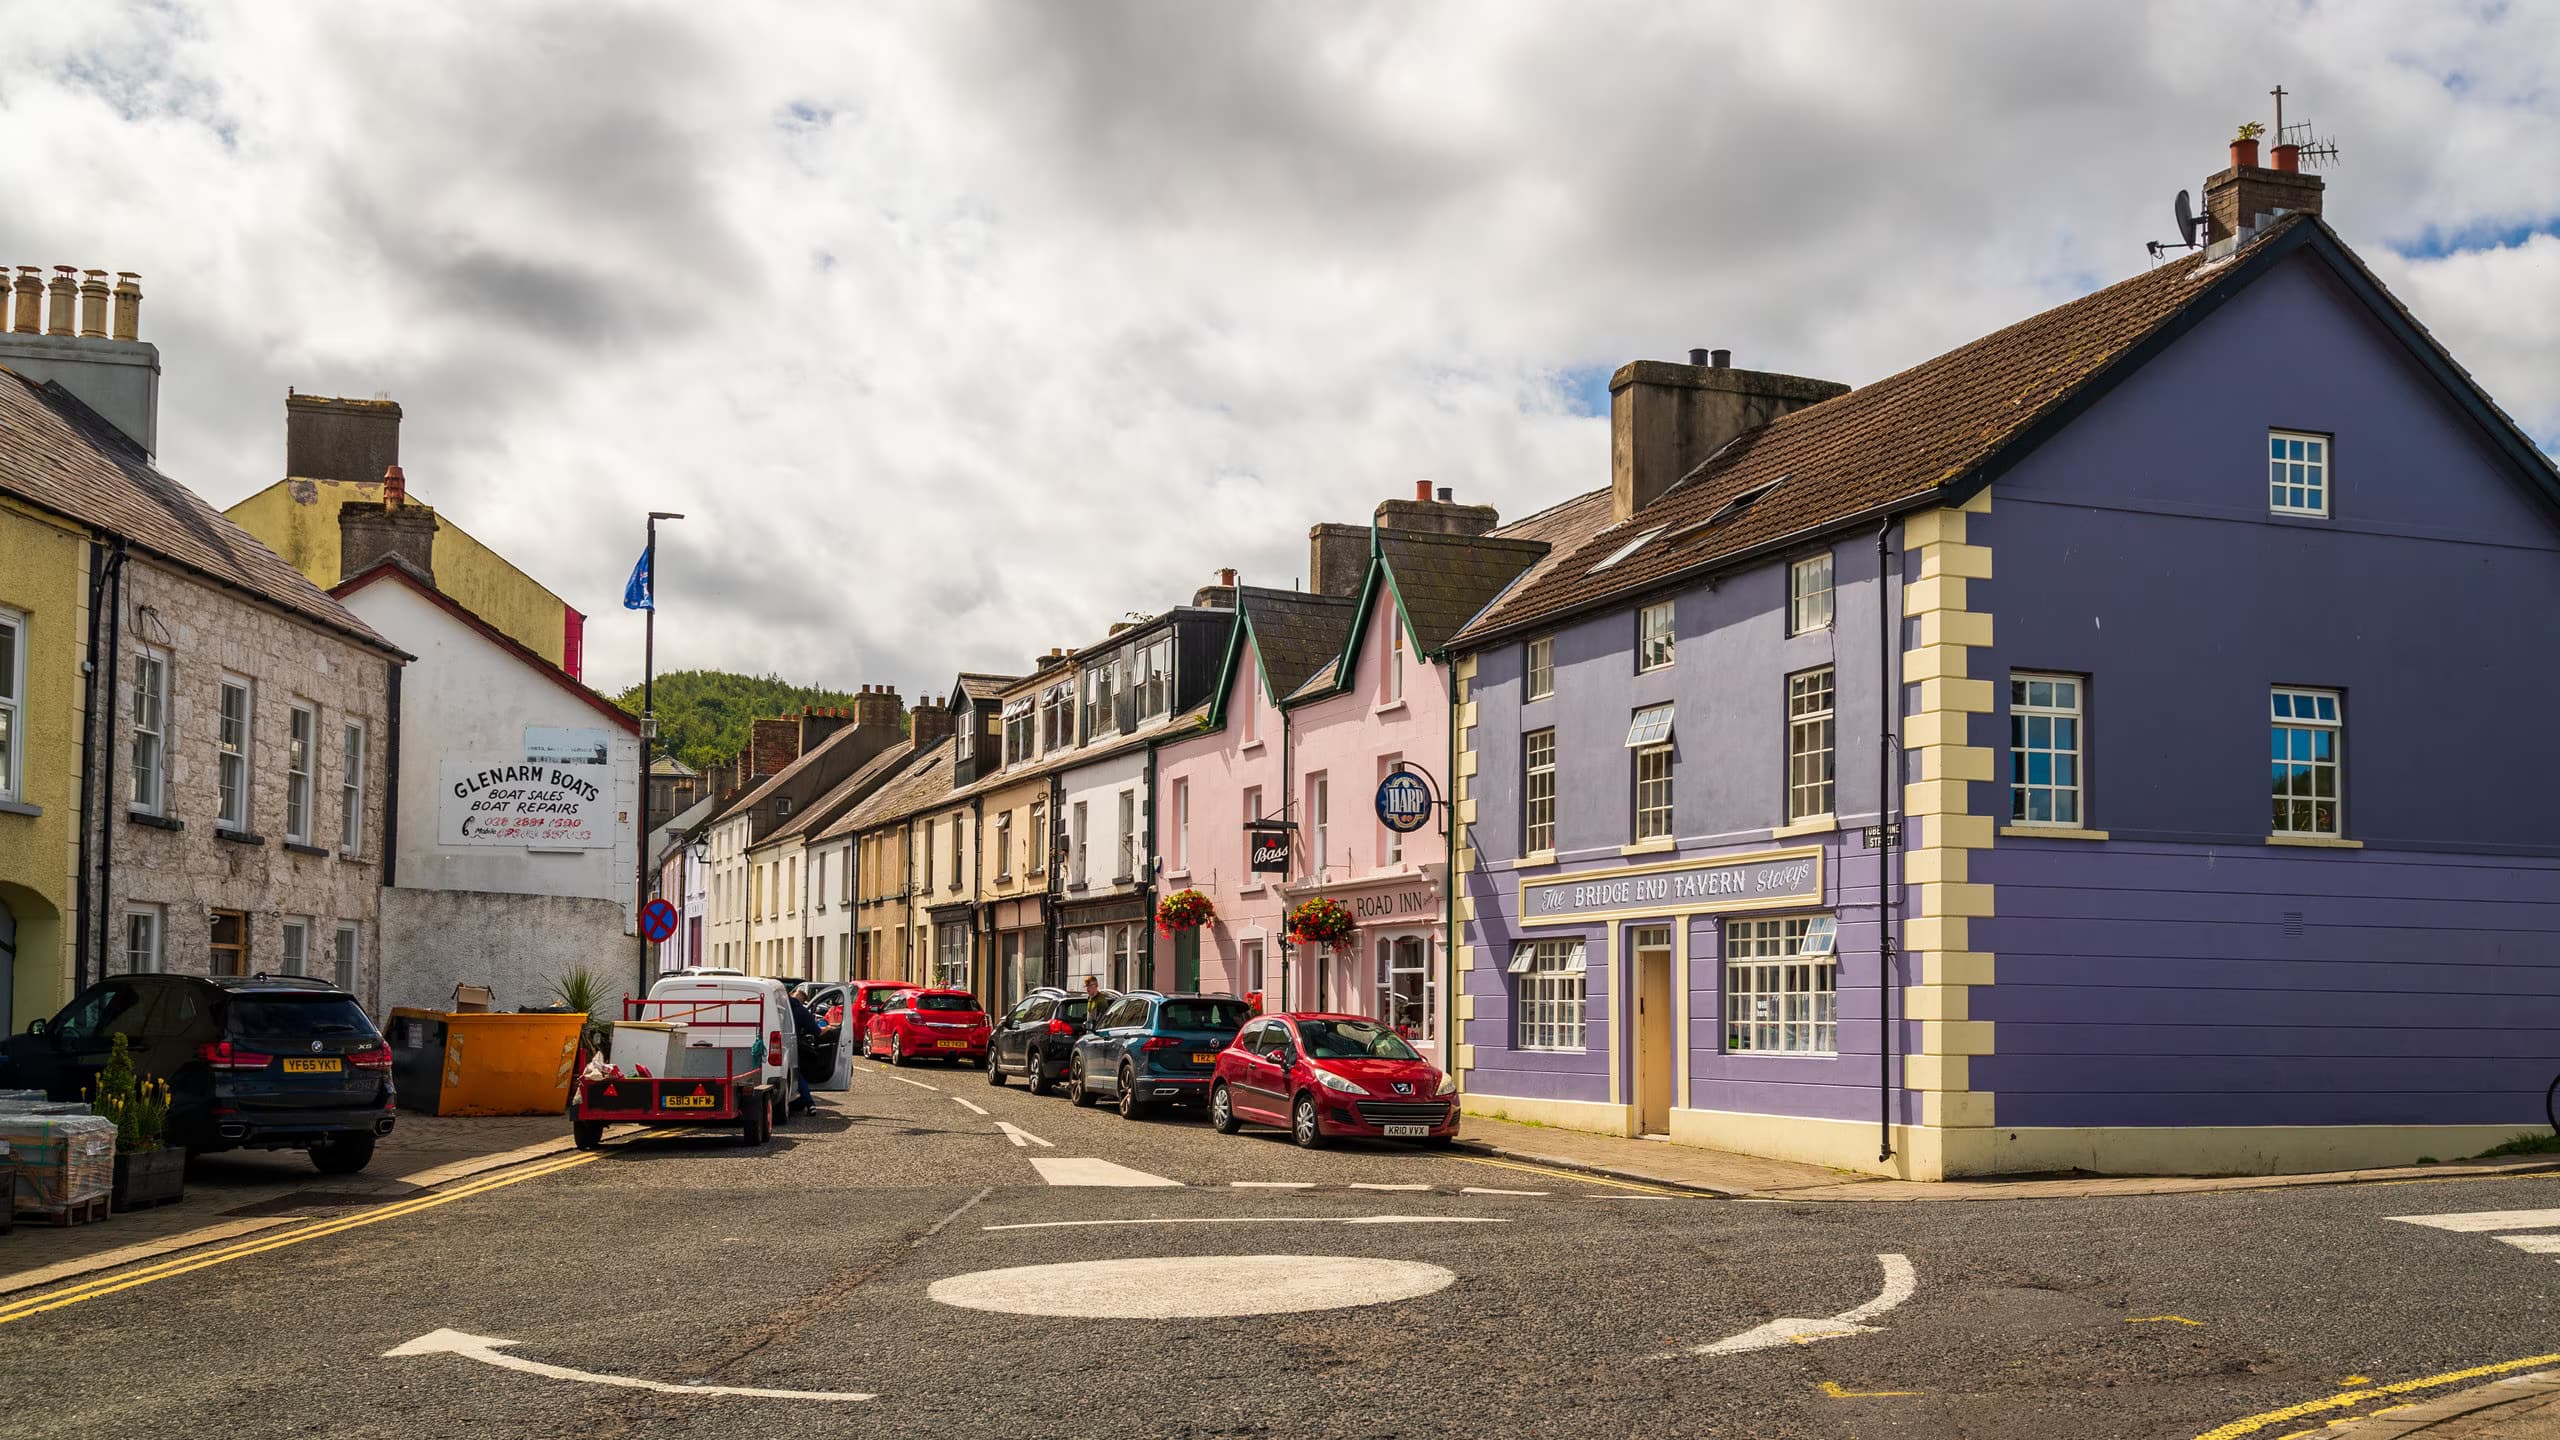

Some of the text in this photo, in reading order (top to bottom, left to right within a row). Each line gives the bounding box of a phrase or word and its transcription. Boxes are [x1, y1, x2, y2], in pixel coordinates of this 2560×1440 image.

[454, 765, 600, 802] GLENARM BOATS
[488, 789, 565, 801] BOAT SALES
[1389, 788, 1424, 813] HARP
[470, 801, 579, 814] BOAT REPAIRS
[1253, 845, 1288, 864] Bass
[1541, 888, 1566, 912] The
[1574, 882, 1630, 908] BRIDGE
[1636, 878, 1668, 902] END
[1674, 869, 1746, 897] TAVERN
[1357, 895, 1393, 917] ROAD
[1399, 892, 1423, 913] INN
[288, 1060, 337, 1071] YF65 YKT
